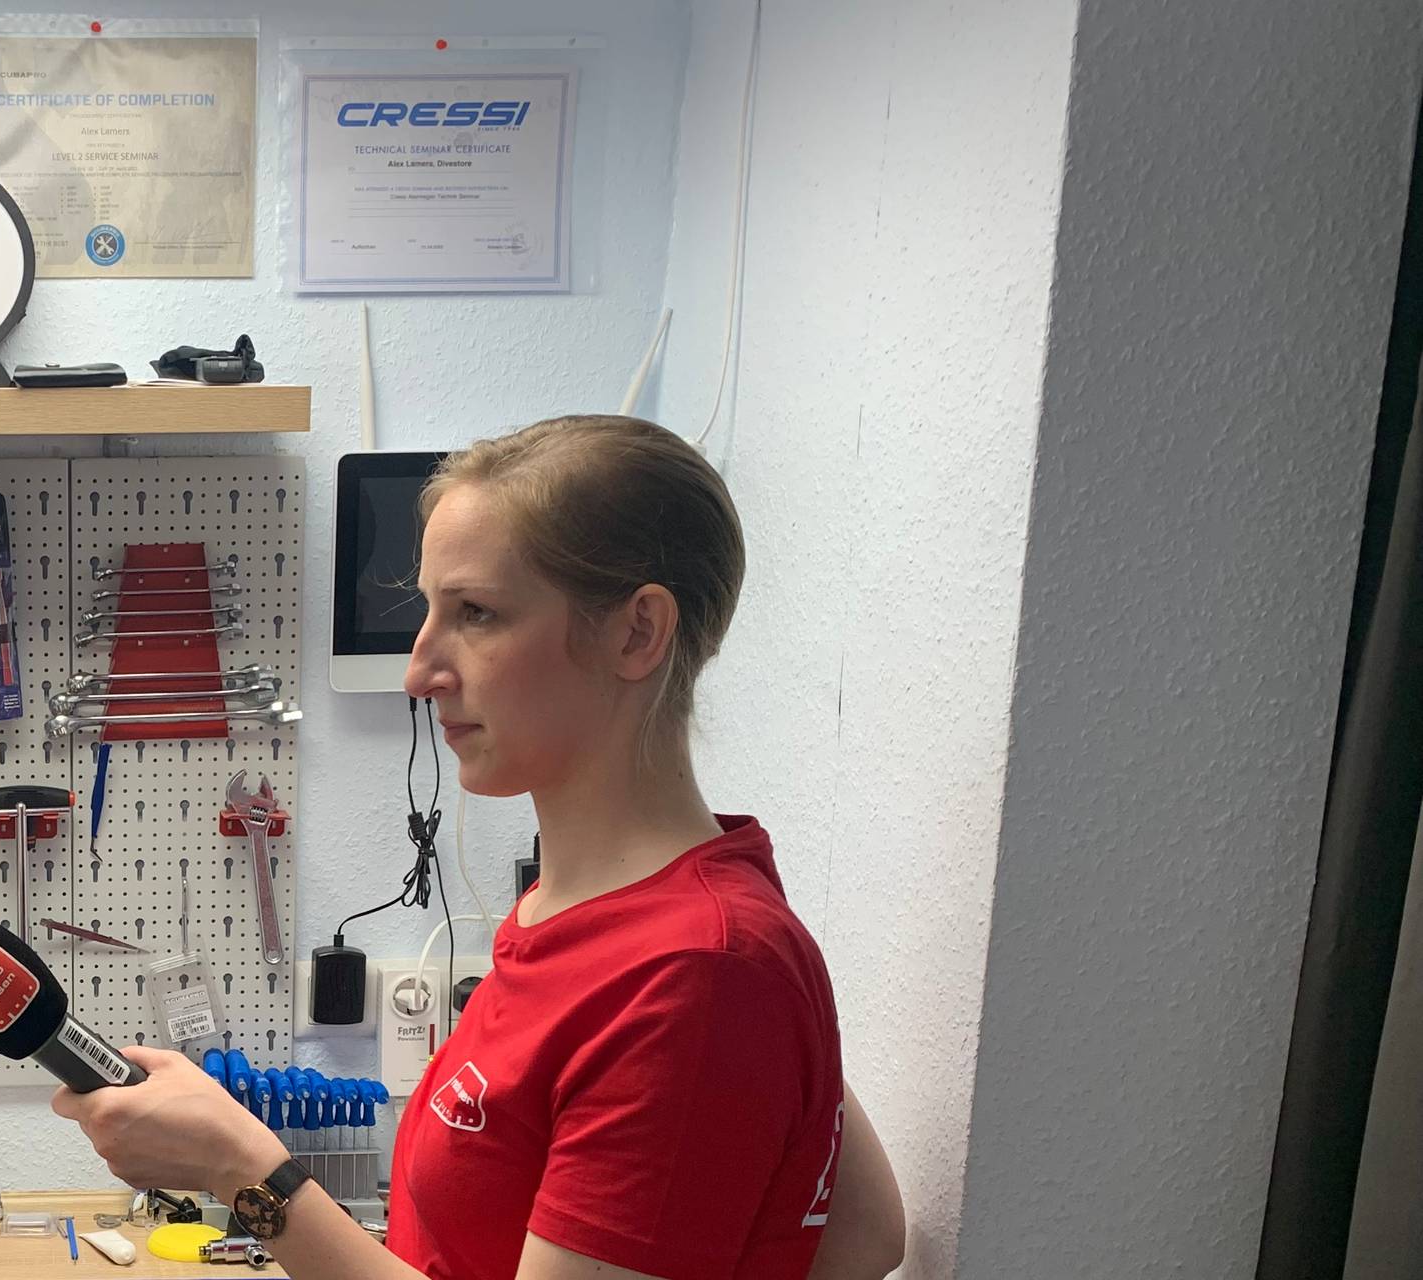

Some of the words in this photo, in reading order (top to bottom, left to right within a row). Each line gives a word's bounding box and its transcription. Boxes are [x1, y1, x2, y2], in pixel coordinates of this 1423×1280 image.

[95, 94, 114, 106] OF
[118, 94, 215, 106] COMPLETION
[337, 101, 530, 127] CRESSI
[81, 127, 99, 136] Alex
[100, 127, 130, 136] Lamers
[355, 145, 407, 155] TECHNICAL
[410, 145, 451, 154] SEMINAR
[455, 144, 511, 154] CERTIFICATE
[52, 152, 77, 161] LEVEL
[78, 152, 83, 161] 2
[84, 152, 118, 161] SERVICE
[120, 152, 159, 161] SEMINAR
[388, 160, 405, 168] Alex
[437, 159, 472, 168] Divestore
